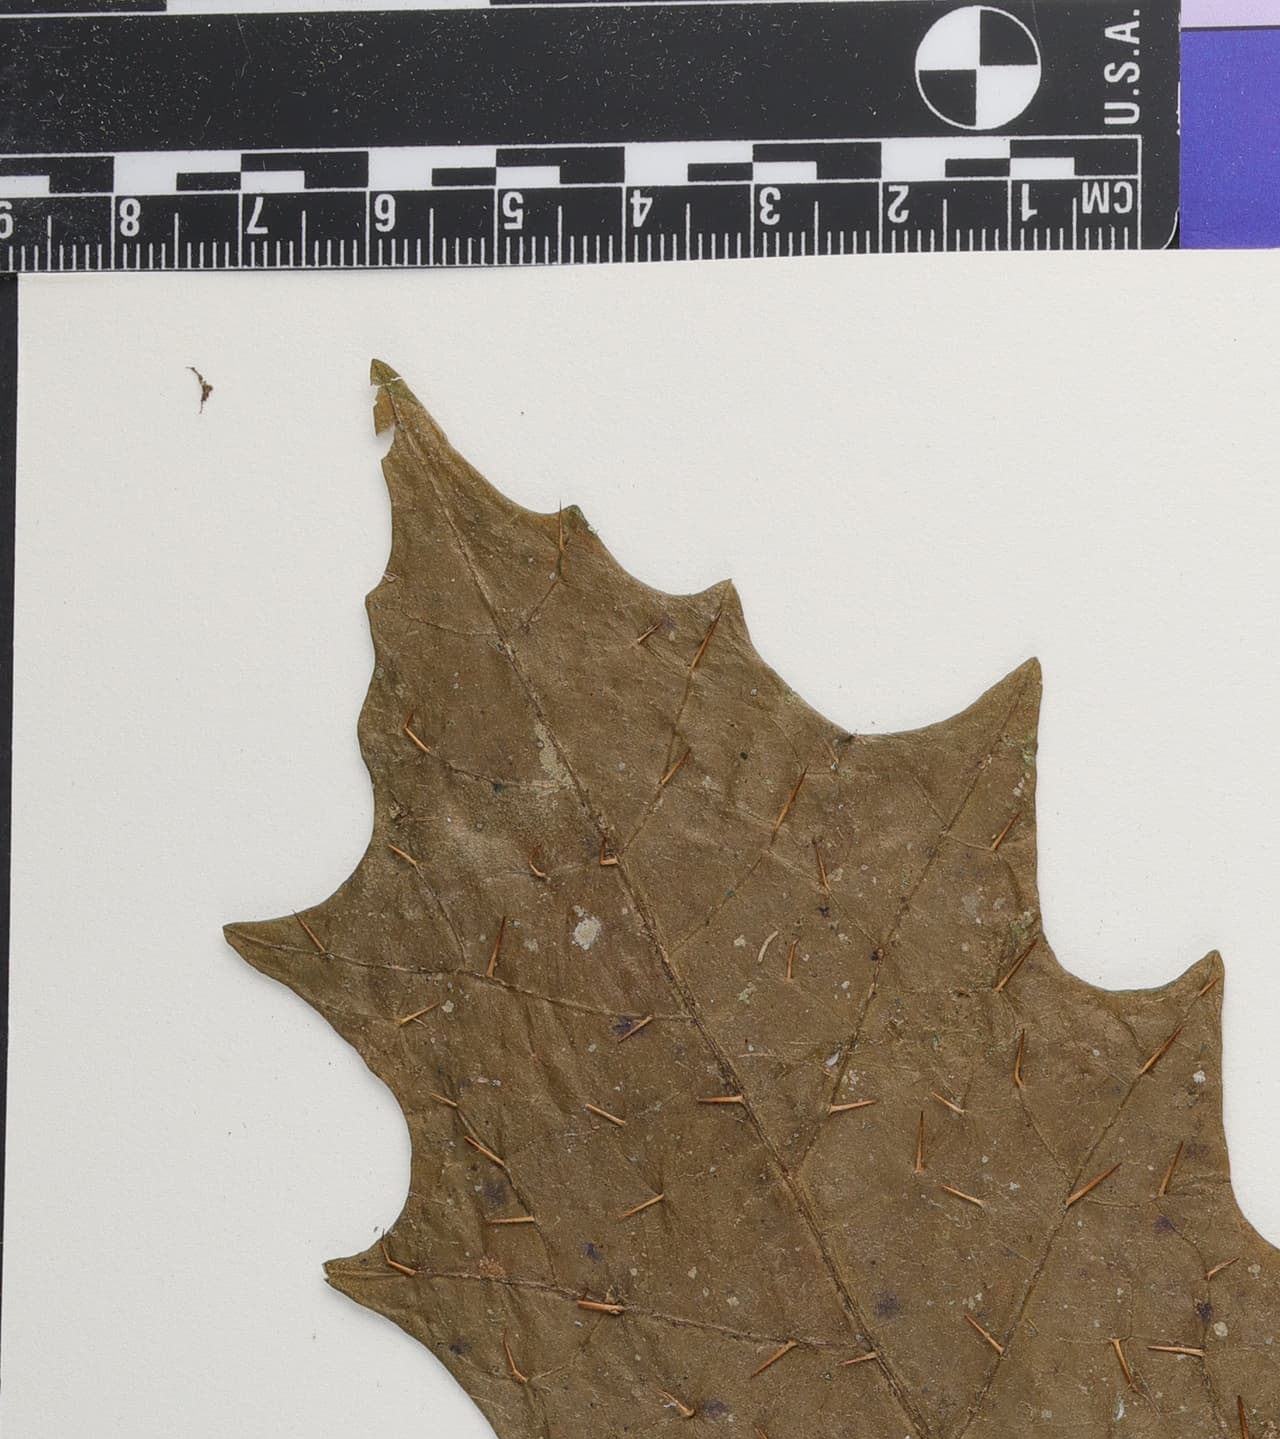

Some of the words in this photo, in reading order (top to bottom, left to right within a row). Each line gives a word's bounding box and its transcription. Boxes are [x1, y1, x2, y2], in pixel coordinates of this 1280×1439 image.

[1103, 9, 1141, 125] U.S.A.
[246, 196, 269, 235] 7
[374, 193, 396, 233] 6
[501, 191, 524, 230] 5
[629, 189, 653, 228] 4
[759, 186, 781, 226] 3
[887, 184, 910, 224] 2
[1019, 183, 1038, 222] 1
[1081, 181, 1133, 214] CM
[119, 198, 141, 237] 8
